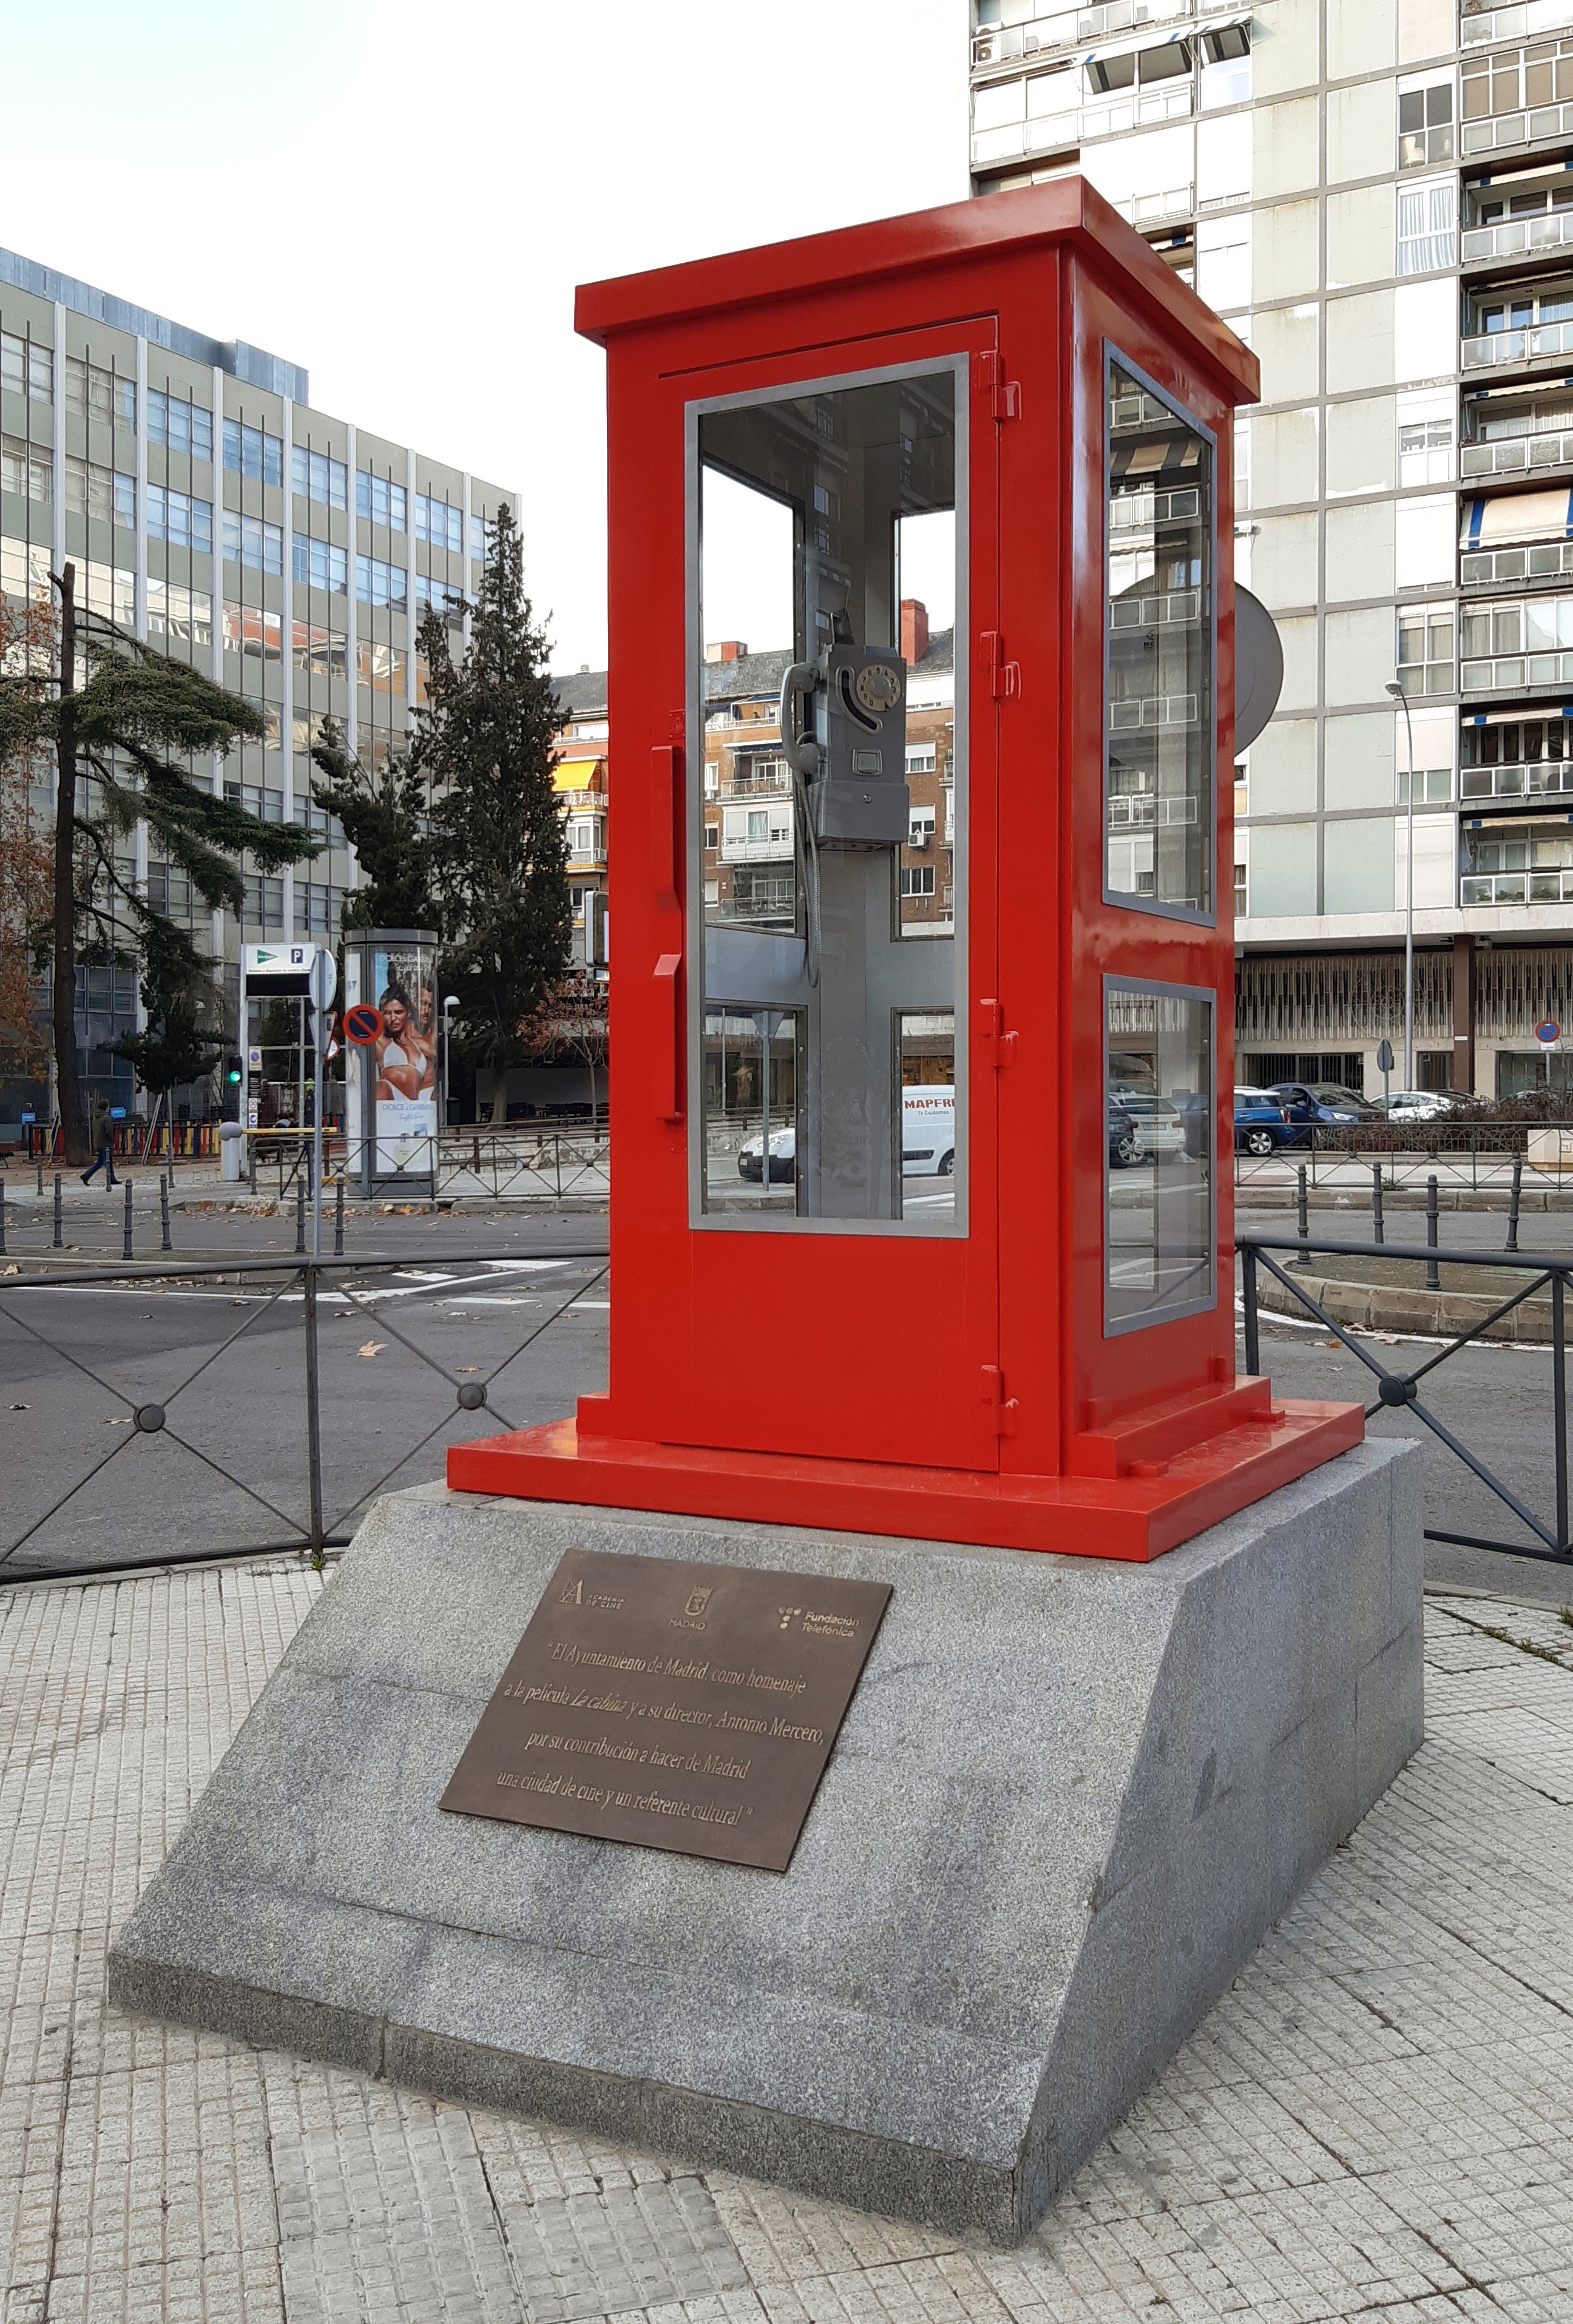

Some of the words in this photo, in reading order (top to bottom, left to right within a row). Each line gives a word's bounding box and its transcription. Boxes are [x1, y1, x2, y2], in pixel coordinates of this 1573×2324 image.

[294, 950, 301, 963] P
[589, 1594, 624, 1603] ACADEMIA
[600, 1601, 623, 1610] CINE
[669, 1619, 706, 1630] MADRID
[805, 1611, 860, 1626] Fundación
[802, 1622, 854, 1637] Telefónica
[564, 1644, 646, 1672] Ayuntamiento
[647, 1655, 664, 1674] de
[711, 1669, 745, 1685] como
[746, 1668, 807, 1698] homenaje
[504, 1684, 513, 1697] a
[513, 1680, 526, 1698] la
[522, 1683, 571, 1705] película
[569, 1689, 589, 1706] La
[587, 1692, 629, 1713] cabina
[626, 1701, 639, 1720] y
[638, 1704, 648, 1716] a
[648, 1704, 663, 1719] su
[664, 1701, 712, 1728] director,
[715, 1711, 768, 1734] Antonio
[768, 1717, 824, 1746] Mercero,
[523, 1732, 549, 1751] por
[549, 1735, 564, 1750] su
[564, 1737, 639, 1762] contribución
[639, 1749, 649, 1763] a
[649, 1745, 685, 1768] hacer
[685, 1752, 701, 1771] de
[701, 1754, 751, 1780] Madrid
[496, 1770, 520, 1788] una
[521, 1770, 563, 1795] ciudad
[560, 1777, 577, 1798] de
[577, 1780, 604, 1802] cine
[600, 1790, 615, 1811] y
[615, 1791, 633, 1807] un
[633, 1791, 691, 1817] referente
